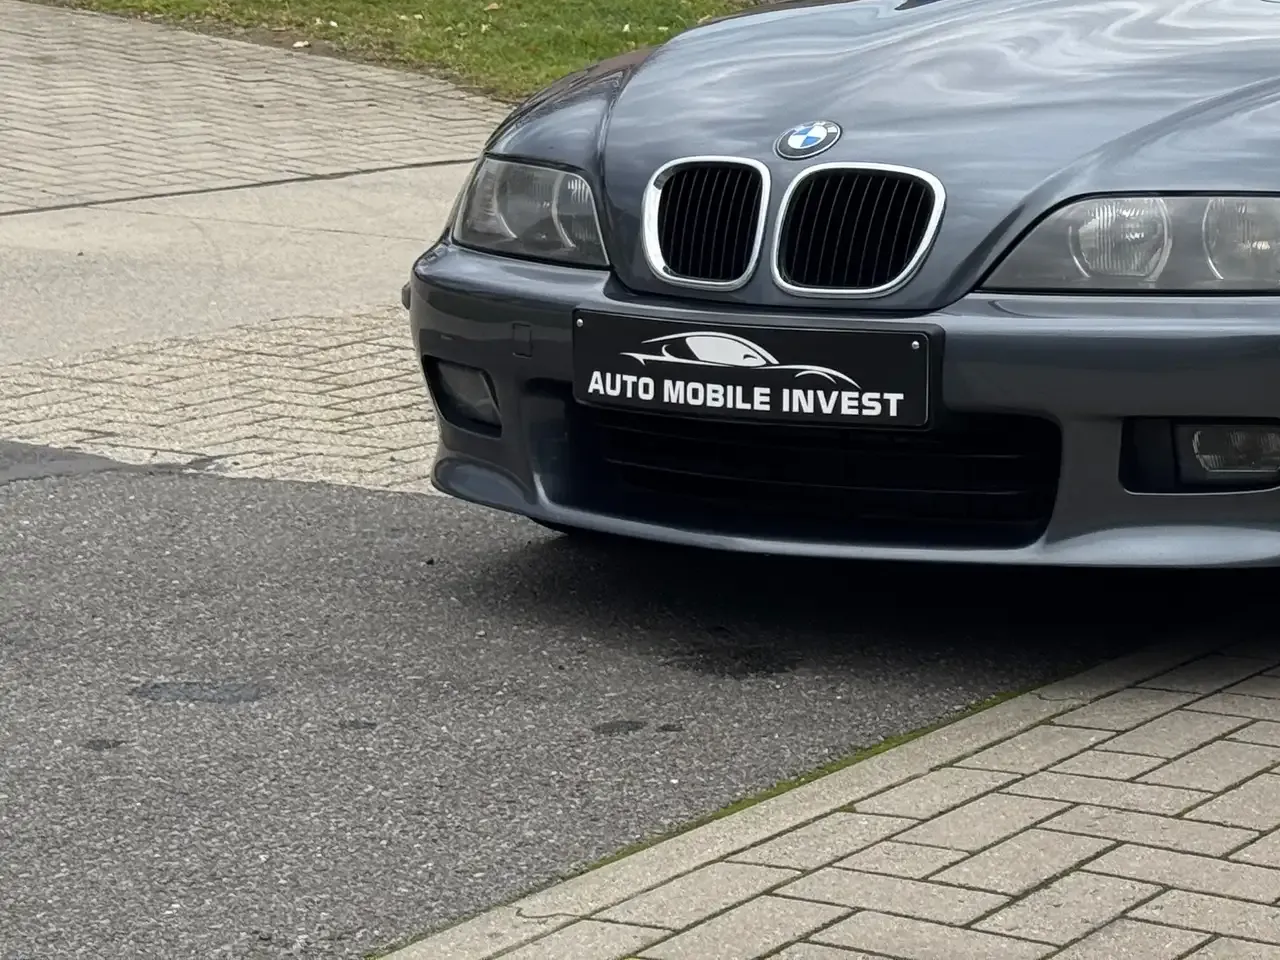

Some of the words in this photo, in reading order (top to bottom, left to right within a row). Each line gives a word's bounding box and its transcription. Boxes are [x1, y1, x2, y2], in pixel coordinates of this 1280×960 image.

[587, 370, 655, 401] AUTO
[663, 379, 771, 411] MOBILE
[782, 388, 905, 417] INVEST
